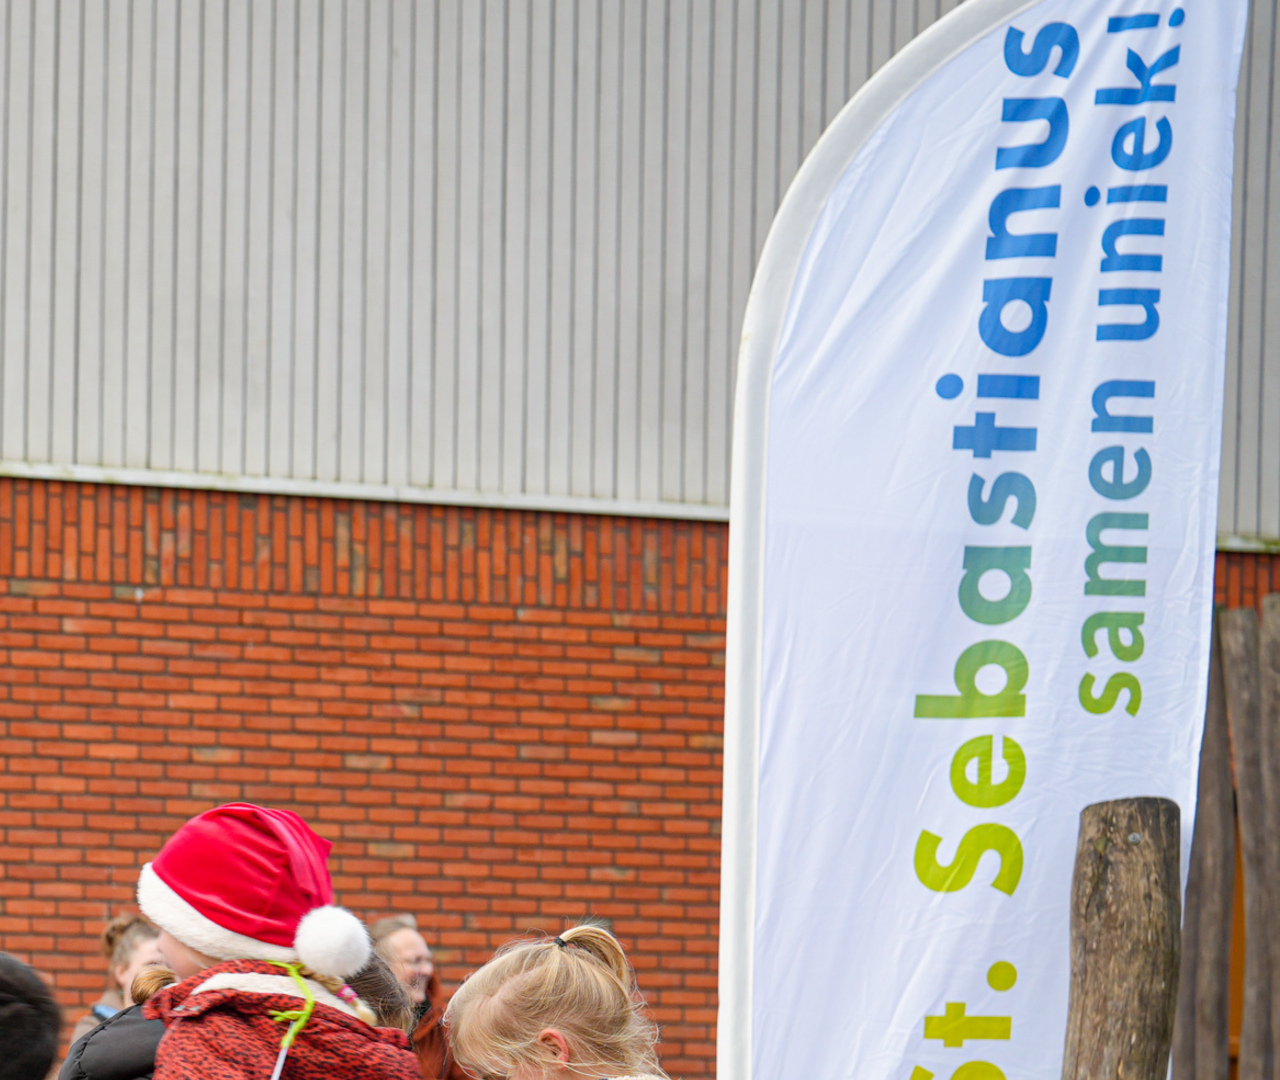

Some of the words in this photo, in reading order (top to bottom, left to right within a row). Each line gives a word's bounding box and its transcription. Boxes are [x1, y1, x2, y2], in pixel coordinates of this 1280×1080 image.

[1085, 7, 1185, 341] uniek!
[913, 20, 1080, 897] Sebastianus
[1078, 378, 1156, 717] samen
